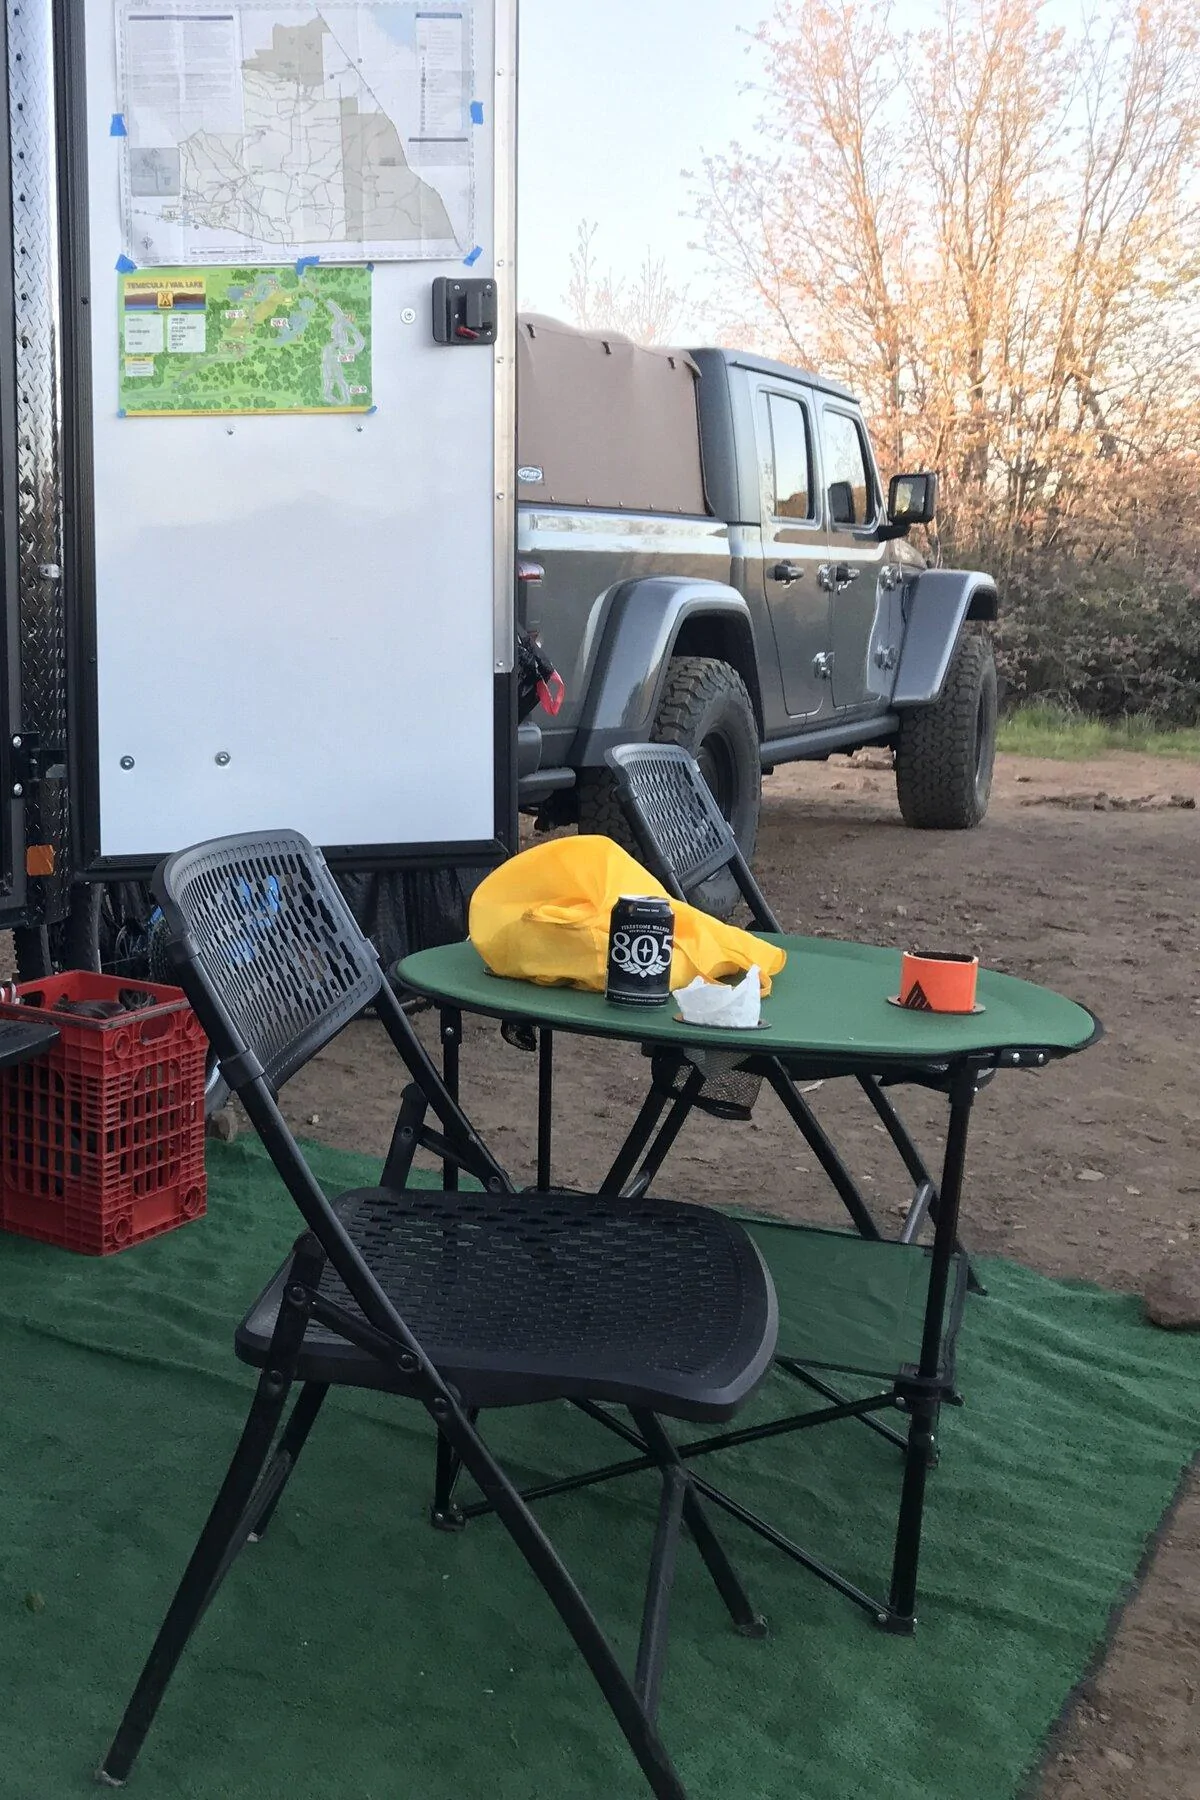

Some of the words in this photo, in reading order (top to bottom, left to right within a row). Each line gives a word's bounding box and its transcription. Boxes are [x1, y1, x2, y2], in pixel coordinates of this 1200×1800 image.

[126, 281, 164, 289] TEMECULA
[621, 923, 651, 931] FIRESTONE
[652, 924, 670, 933] WALKER
[611, 931, 674, 967] 805
